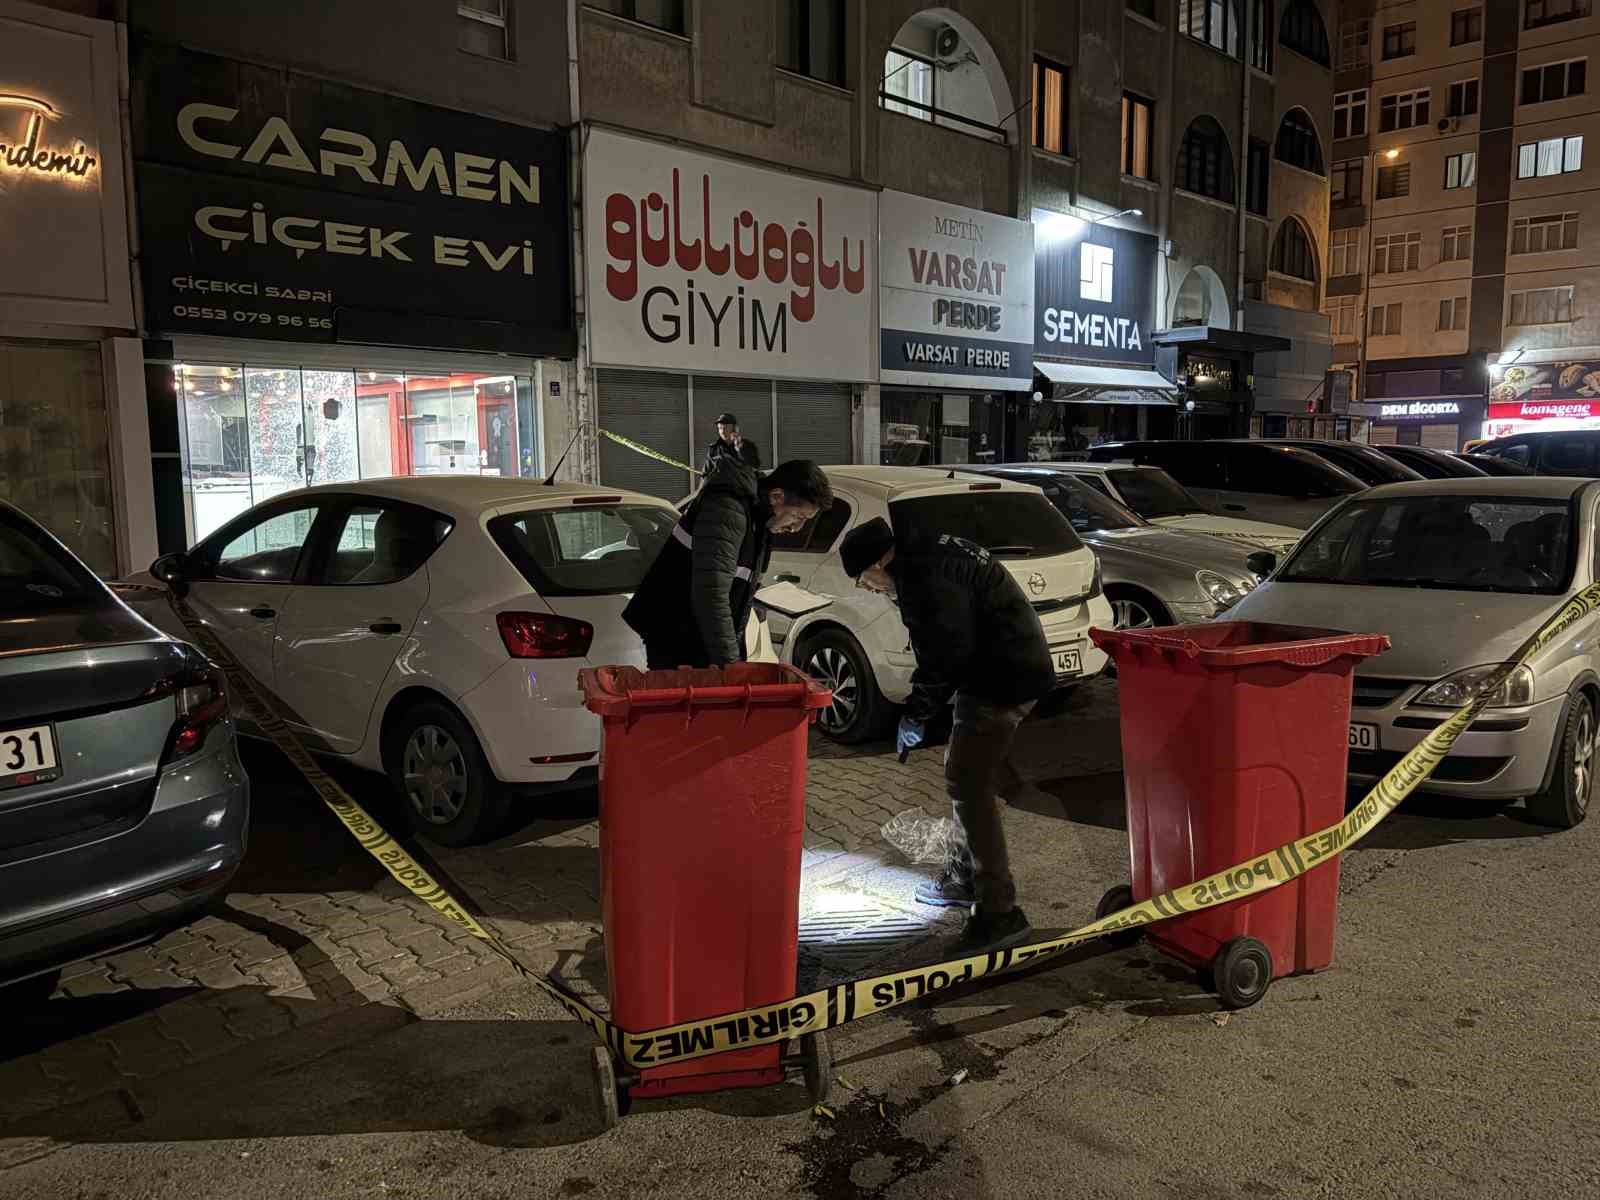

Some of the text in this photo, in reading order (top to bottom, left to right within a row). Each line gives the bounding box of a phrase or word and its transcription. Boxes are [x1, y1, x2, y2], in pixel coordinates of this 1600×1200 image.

[177, 102, 540, 204] CARMEN
[195, 202, 534, 276] ÇİÇEK EVİ
[934, 216, 984, 242] METİN
[908, 247, 1007, 297] VARSAT
[171, 276, 332, 304] ÇİÇEKCİ SABRİ
[172, 305, 333, 329] 0553 079 96 56
[641, 279, 787, 353] GİYİM
[932, 299, 1001, 332] PERDE
[1043, 307, 1143, 352] SEMENTA
[905, 342, 1010, 369] VARSAT PERDE
[1520, 403, 1591, 417] komagene
[1058, 653, 1078, 670] 457
[2, 730, 45, 771] 31
[1349, 726, 1370, 747] 60
[630, 963, 973, 1063] POLİS GİRİLMEZ
